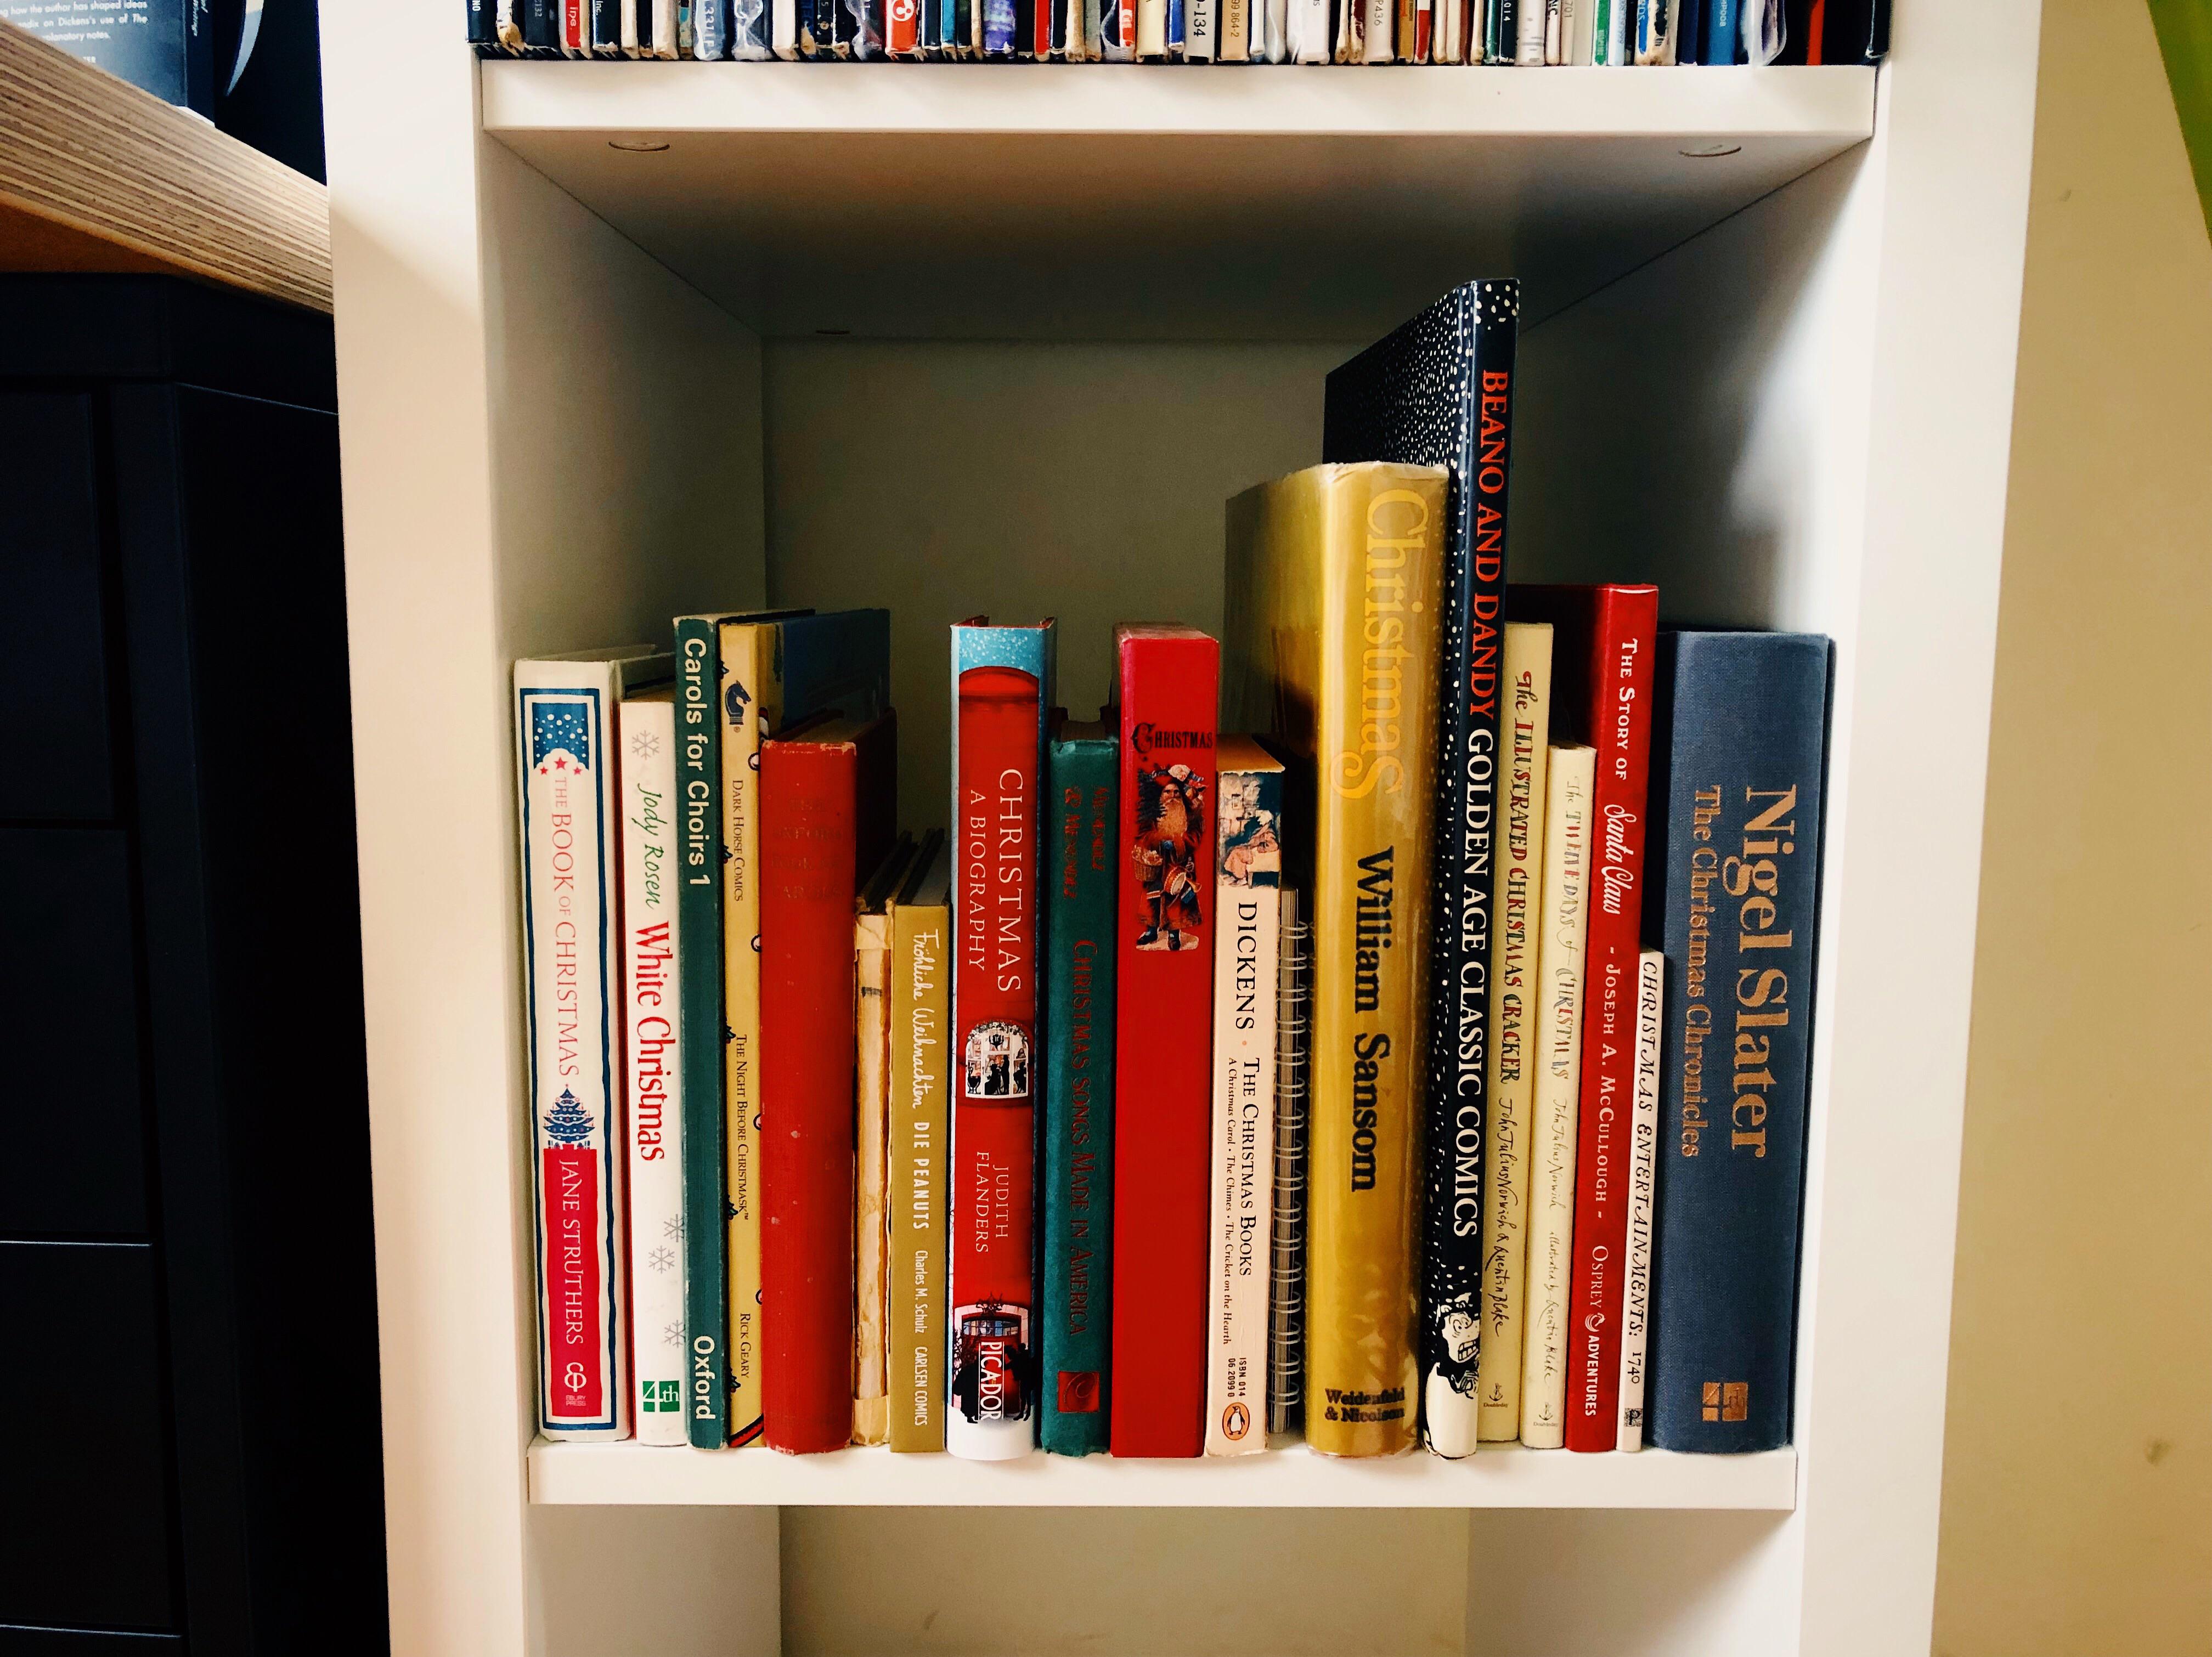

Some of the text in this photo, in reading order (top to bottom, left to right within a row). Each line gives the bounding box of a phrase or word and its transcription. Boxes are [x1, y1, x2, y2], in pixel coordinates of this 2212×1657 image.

[30, 4, 43, 14] the
[45, 4, 71, 13] author
[74, 1, 89, 11] has
[118, 13, 129, 24] of
[132, 13, 148, 24] The
[1231, 12, 1240, 37] 864-2
[1329, 489, 1429, 799] Christmas
[1131, 722, 1213, 754] CHRISTMAS
[1615, 638, 1639, 781] THE STORY OF
[685, 637, 710, 886] Carols for Choirs 1
[1453, 370, 1508, 1237] BEANO AND DANDY GOLDEN AGE CLASSIC COMICS
[631, 783, 668, 909] Jody Rosen
[732, 779, 745, 902] DARK HORSE COMICS
[967, 789, 986, 971] A BIOGRAPHY
[996, 768, 1024, 993] CHRISTMAS
[1500, 671, 1534, 1085] The ILLUSTRATED CHRISTMAS CRACKER
[1600, 804, 1637, 915] Santa Claus
[550, 777, 579, 1076] THE BOOK OF CHRISTMAS
[1559, 884, 1579, 927] DAYS
[1235, 901, 1257, 1031] DICKENS
[1602, 964, 1621, 1035] JOSEPH
[1681, 784, 1721, 1158] The Christmas Chronicles
[1722, 784, 1797, 1158] Nigel Slater
[635, 920, 676, 1161] White Christmas
[736, 1034, 748, 1058] THE
[1352, 845, 1395, 1193] William Sansom
[1600, 1043, 1616, 1066] A.
[1638, 961, 1657, 1112] CHRISTMAS
[736, 1060, 748, 1098] NIGHT
[736, 1101, 748, 1141] BEFORE
[912, 928, 940, 1230] Fröhliche Weihnachten DIE PEANUTS
[1497, 1097, 1514, 1131] John
[1069, 939, 1097, 1336] CHRISTMAS SONGS MADE IN AMERICA
[1239, 1057, 1260, 1276] THE CHRISTMAS BOOKS
[1496, 1130, 1518, 1179] Julius
[974, 1151, 990, 1253] FLANDERS
[993, 1164, 1011, 1237] JUDITH
[1223, 1057, 1238, 1345] A Christmas Carol The Chimes The Cricket on the Hearth
[1495, 1179, 1517, 1229] Norwich
[558, 1158, 583, 1345] JANE STRUTHERS
[915, 1250, 929, 1333] Charles M. Schulz
[1485, 1246, 1509, 1292] Quentin
[739, 1313, 751, 1378] RICK GEARY
[1492, 1293, 1510, 1337] Blake
[1584, 1245, 1609, 1416] OSPREY ADVENTURES
[693, 1336, 716, 1420] Oxford
[914, 1346, 928, 1426] CARLSEN COMICS
[979, 1341, 1003, 1420] PICADOR
[1238, 1357, 1247, 1396] ISBN 014
[1543, 1344, 1556, 1383] Blake
[1325, 1406, 1338, 1421] &
